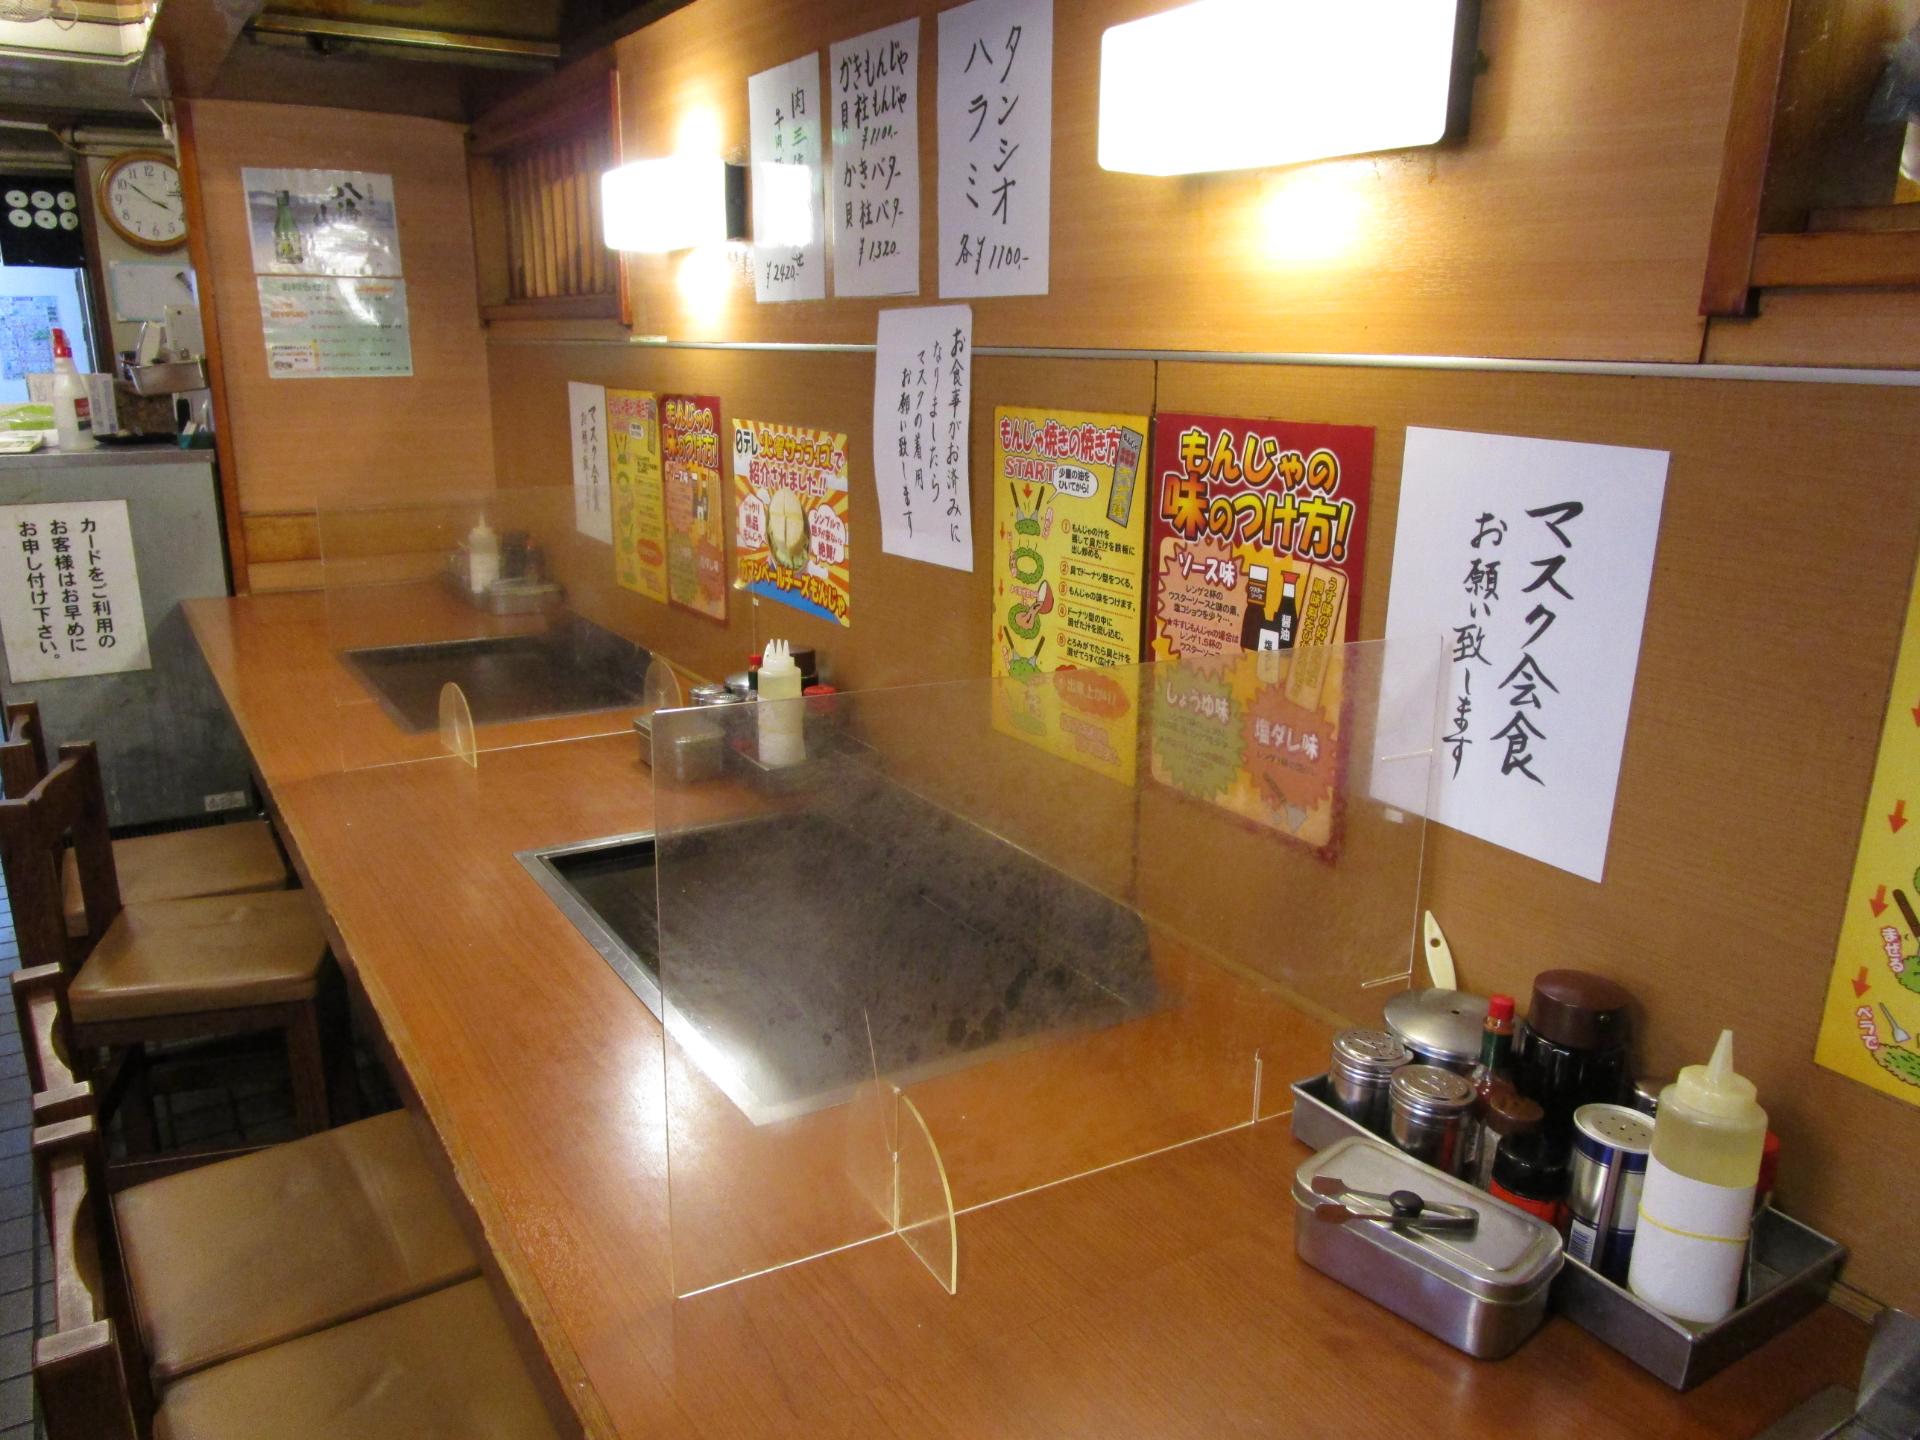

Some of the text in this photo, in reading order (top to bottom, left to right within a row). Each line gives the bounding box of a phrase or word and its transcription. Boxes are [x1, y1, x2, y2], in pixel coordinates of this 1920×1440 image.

[841, 85, 907, 132] 貝柱もんじゃ
[844, 155, 901, 190] かきバター
[964, 38, 993, 208] ハラミ
[992, 25, 1021, 224] タンシオ
[845, 198, 904, 229] 貝柱バター
[898, 368, 912, 539] お願い致します
[913, 351, 926, 490] マスクの着用
[929, 340, 942, 503] なりましたら
[945, 328, 965, 543] お食事がお済みに
[1004, 456, 1056, 483] START
[1180, 427, 1341, 494] もんじゃの
[80, 518, 116, 649] カードをご利用の
[1162, 472, 1354, 562] 味のつけ方!
[1178, 552, 1237, 590] ソース味
[19, 521, 60, 659] お申し付け下さい。
[50, 519, 87, 653] お客様はお早めに
[1442, 512, 1508, 781] お願い致します
[1490, 501, 1583, 787] マスク会食
